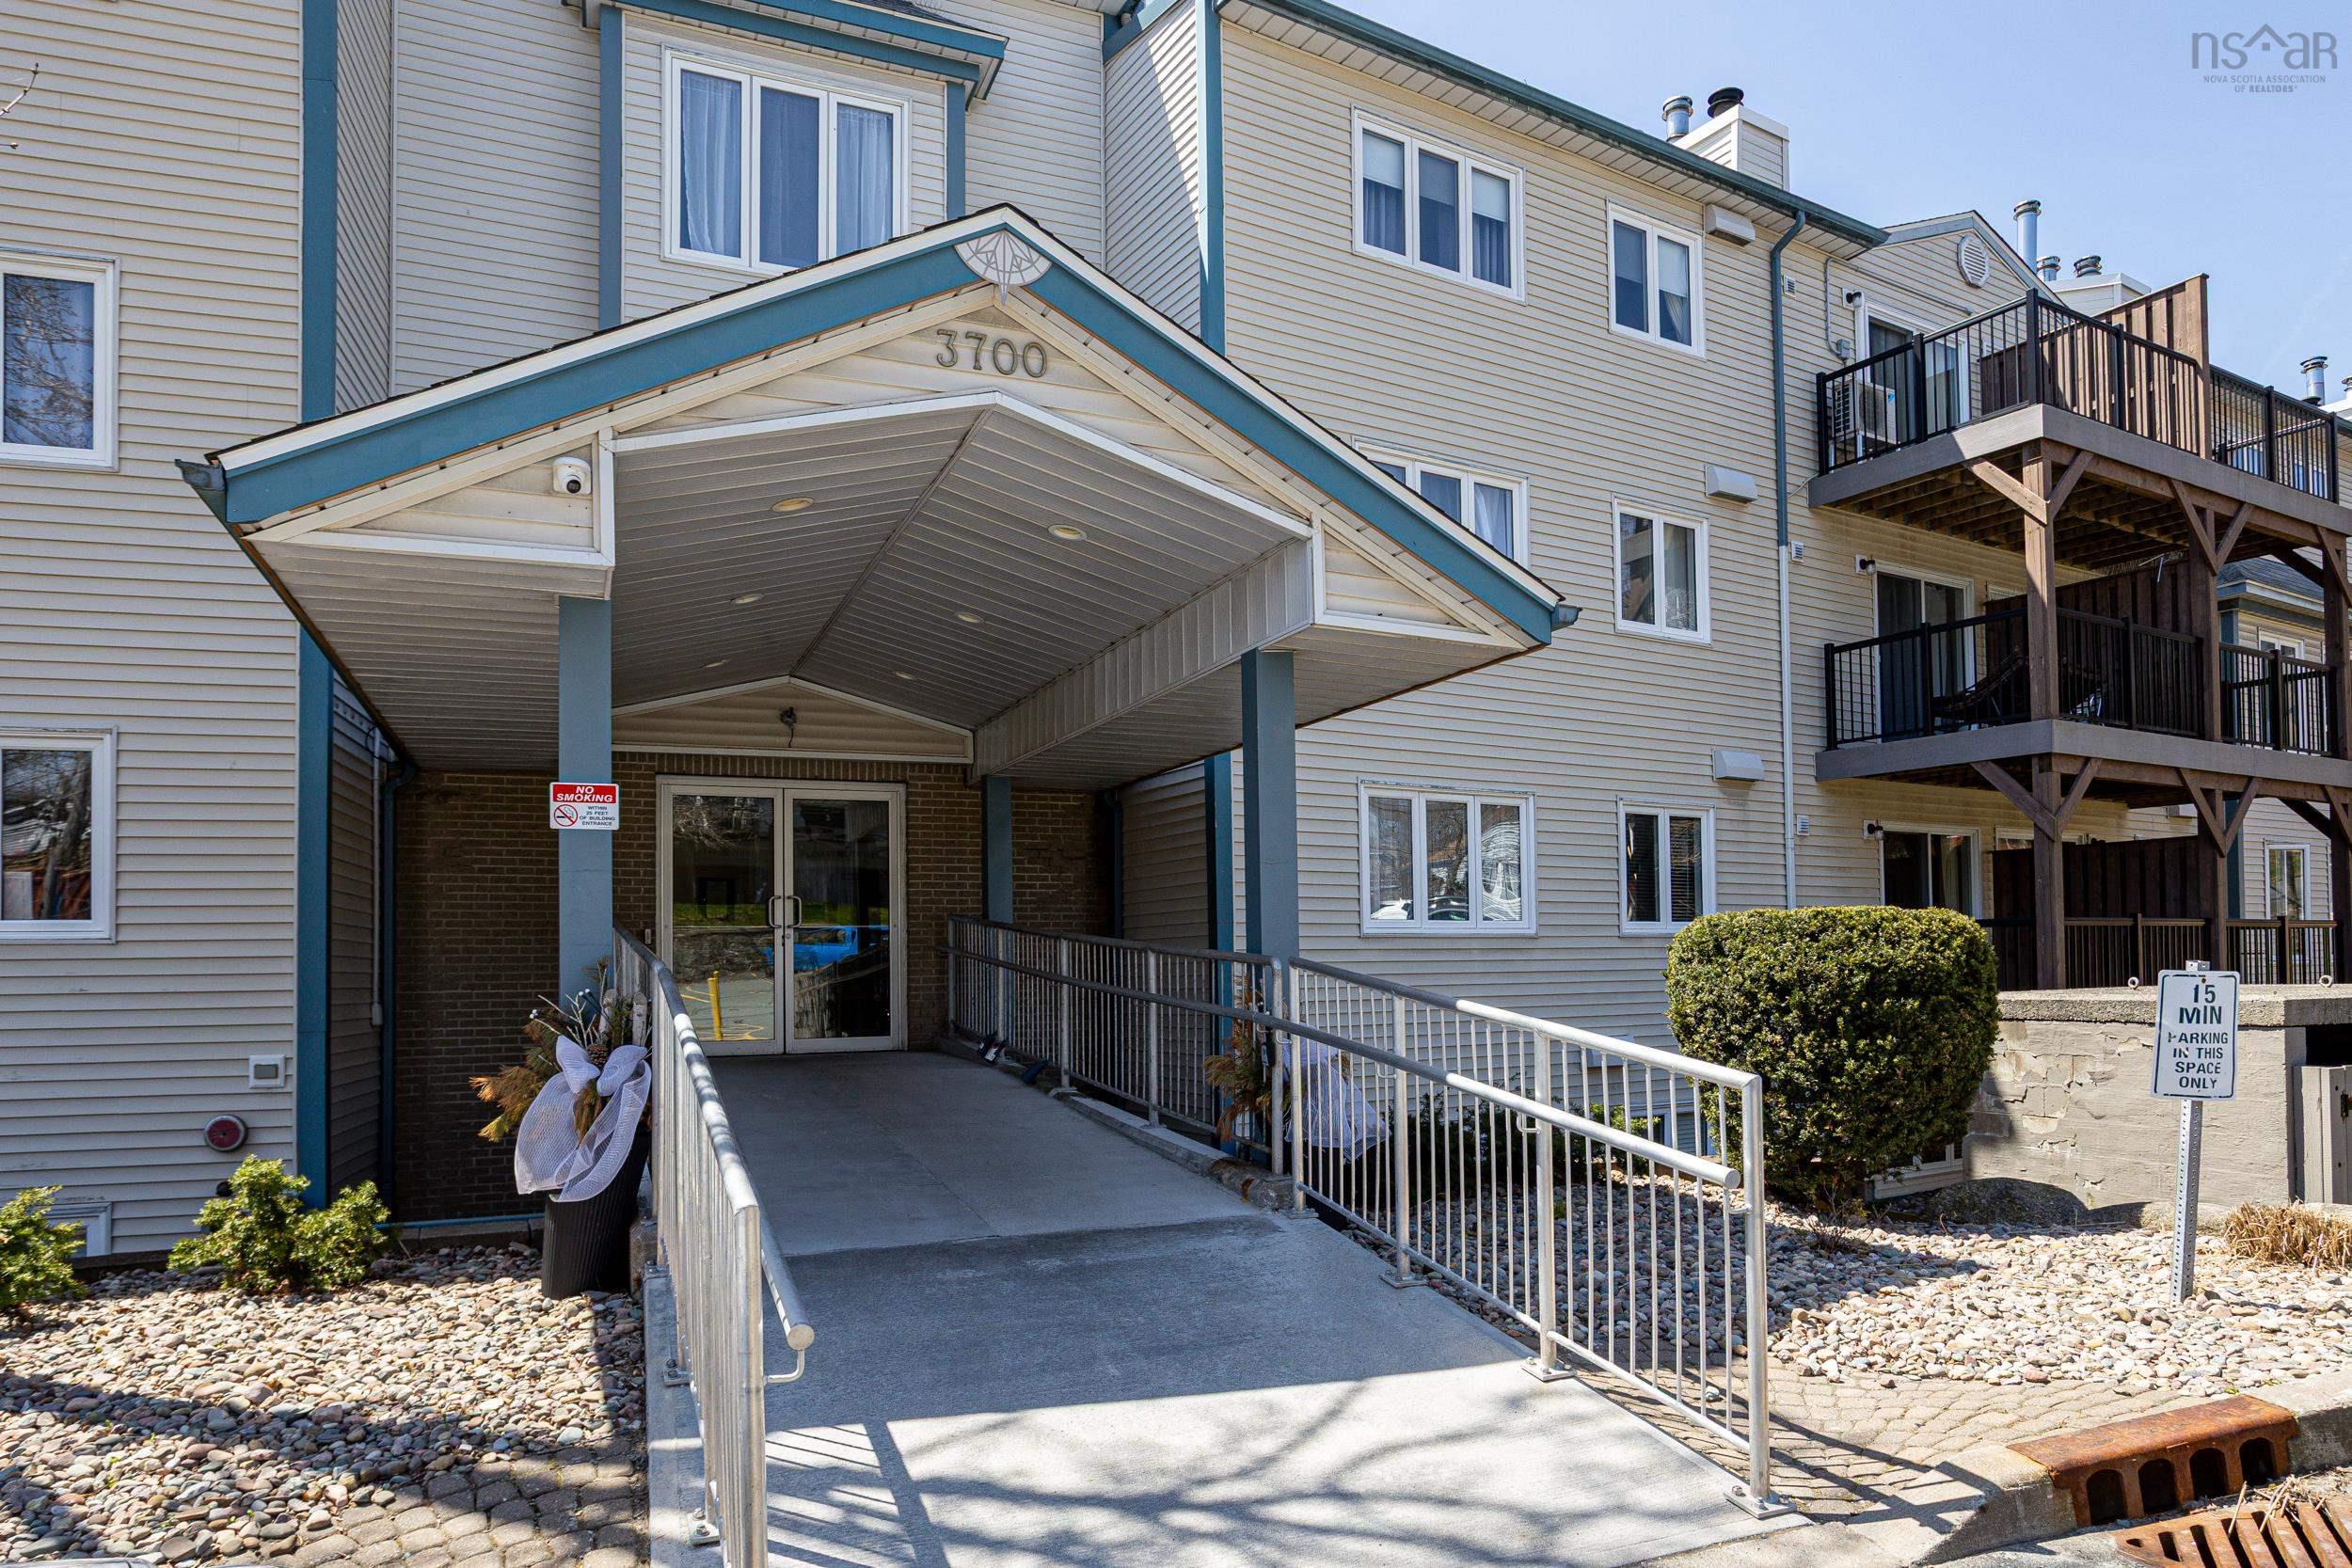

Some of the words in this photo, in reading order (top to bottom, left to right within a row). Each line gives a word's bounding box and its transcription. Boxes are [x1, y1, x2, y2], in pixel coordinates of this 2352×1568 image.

[936, 329, 1047, 378] 3700
[576, 785, 595, 794] NO
[556, 793, 613, 802] SMOKING
[2193, 984, 2216, 1004] 15
[2179, 1006, 2222, 1024] MIN
[2172, 1047, 2189, 1058] IN
[2196, 1047, 2223, 1059] THIS
[2175, 1061, 2221, 1074] SPACE
[2179, 1076, 2217, 1089] ONLY
